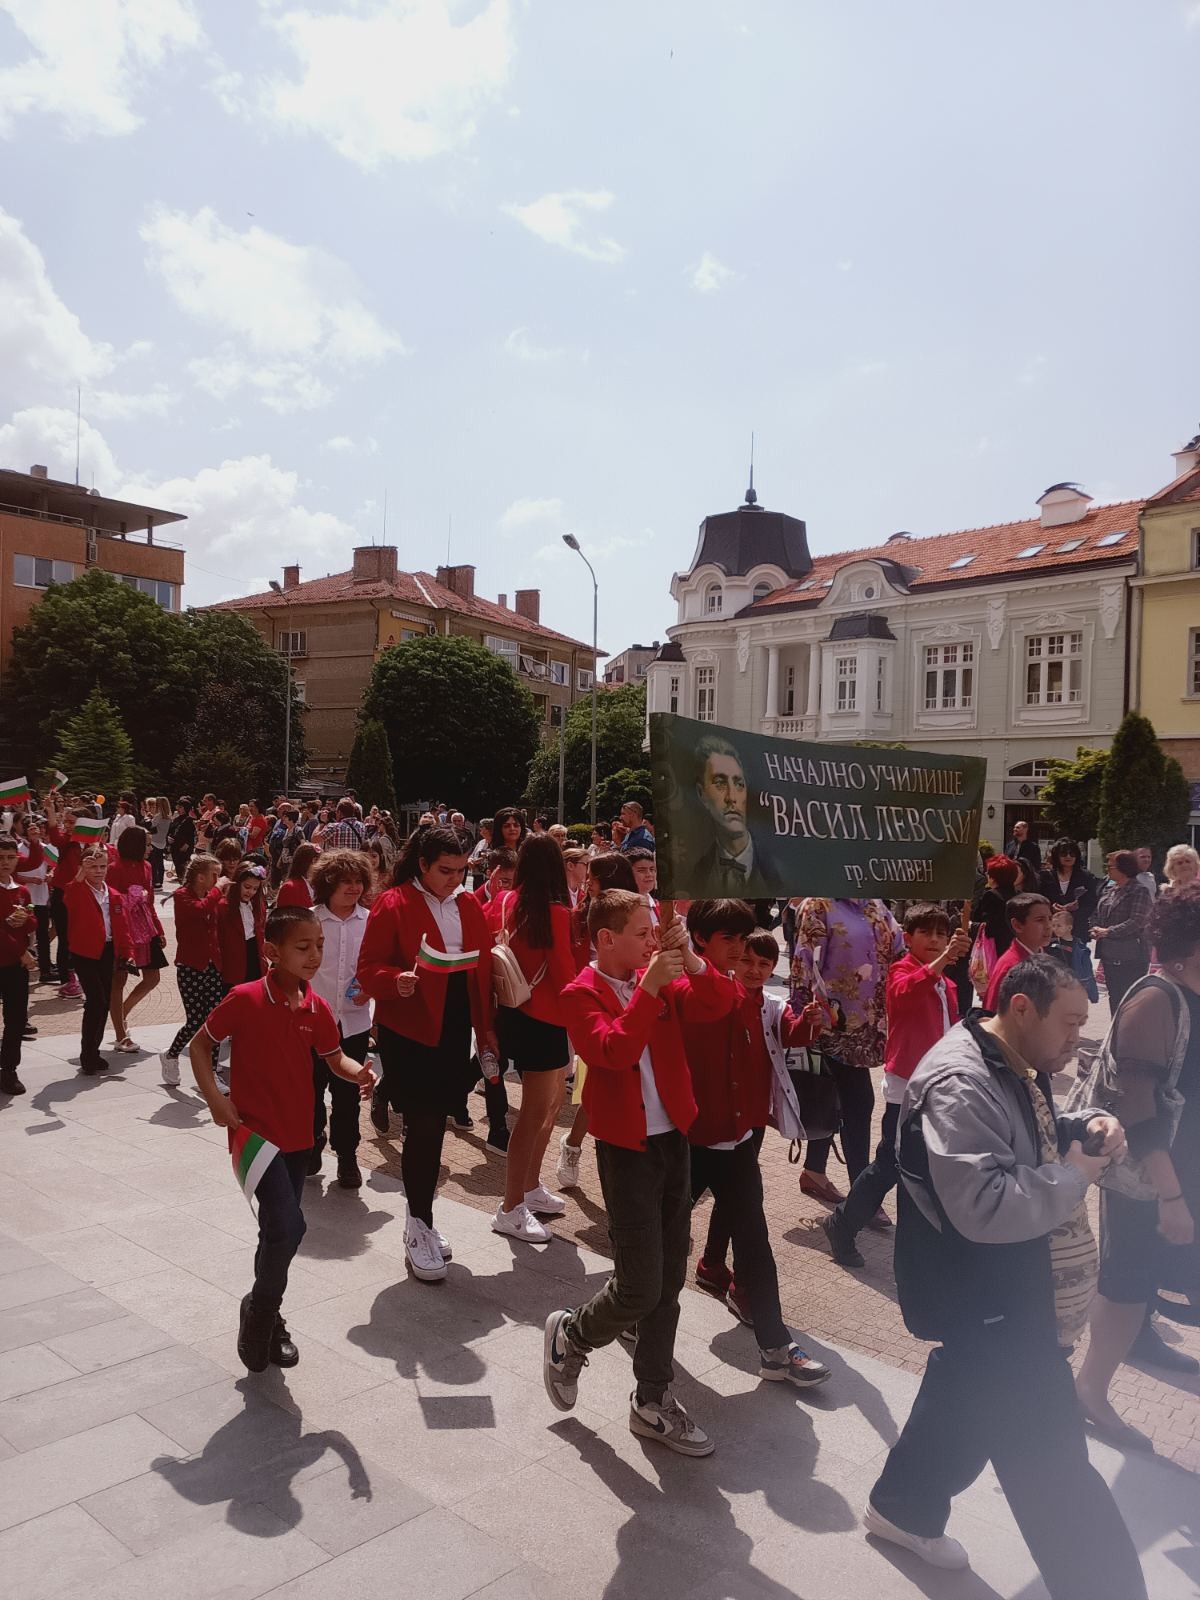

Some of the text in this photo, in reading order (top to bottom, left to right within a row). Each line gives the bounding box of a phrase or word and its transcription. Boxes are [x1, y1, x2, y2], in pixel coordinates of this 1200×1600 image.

[763, 752, 964, 799] НАЧАЛНО УЧИЛИЩЕ
[843, 858, 934, 889] гр. СЛИВЕН
